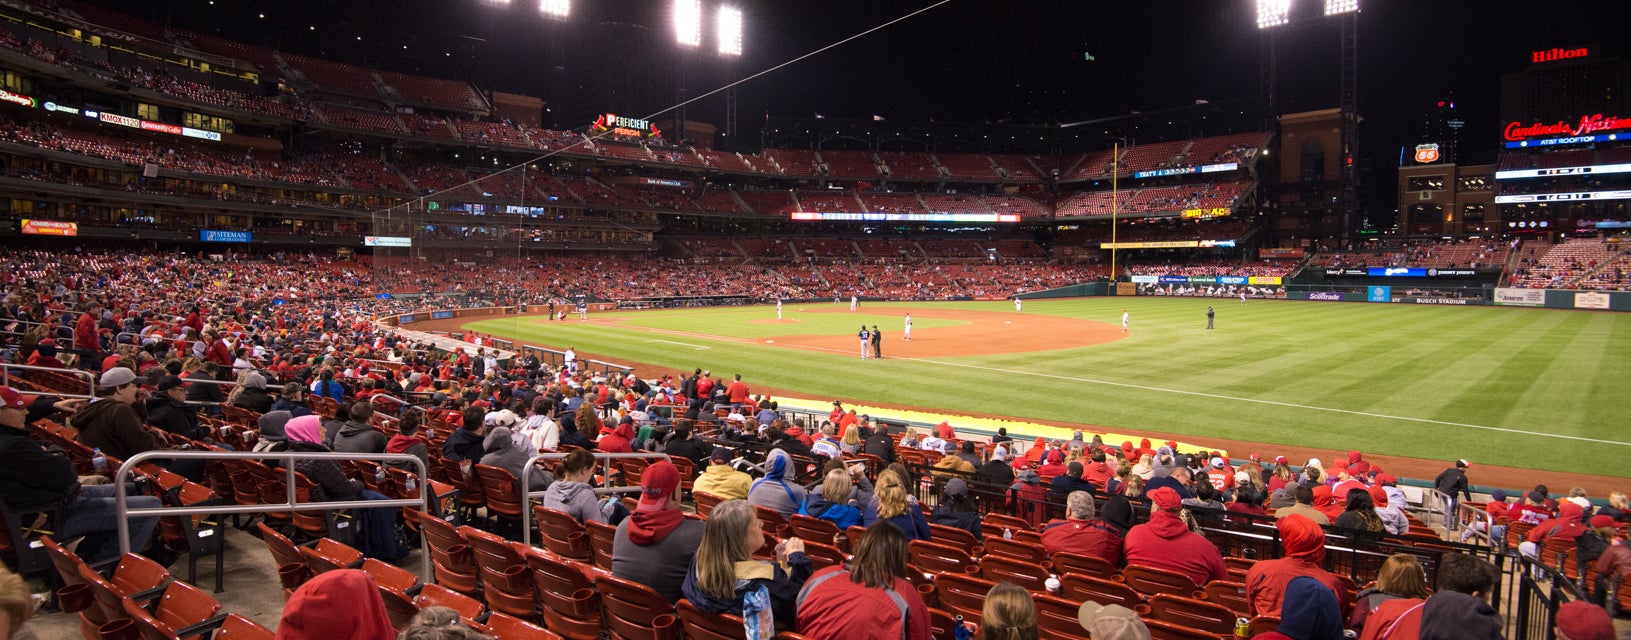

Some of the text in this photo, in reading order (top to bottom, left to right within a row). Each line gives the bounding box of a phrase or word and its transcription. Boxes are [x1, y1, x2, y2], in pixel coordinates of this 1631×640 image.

[1532, 48, 1588, 63] Hilton
[606, 113, 649, 130] PERFICIENT
[614, 127, 640, 137] PERCH
[1504, 121, 1572, 141] Cardinals
[1558, 136, 1596, 144] ROOFTOP
[1419, 150, 1435, 160] 66
[1185, 209, 1202, 218] BIG
[216, 231, 247, 239] SITEMAN
[1309, 291, 1340, 301] Scottrade
